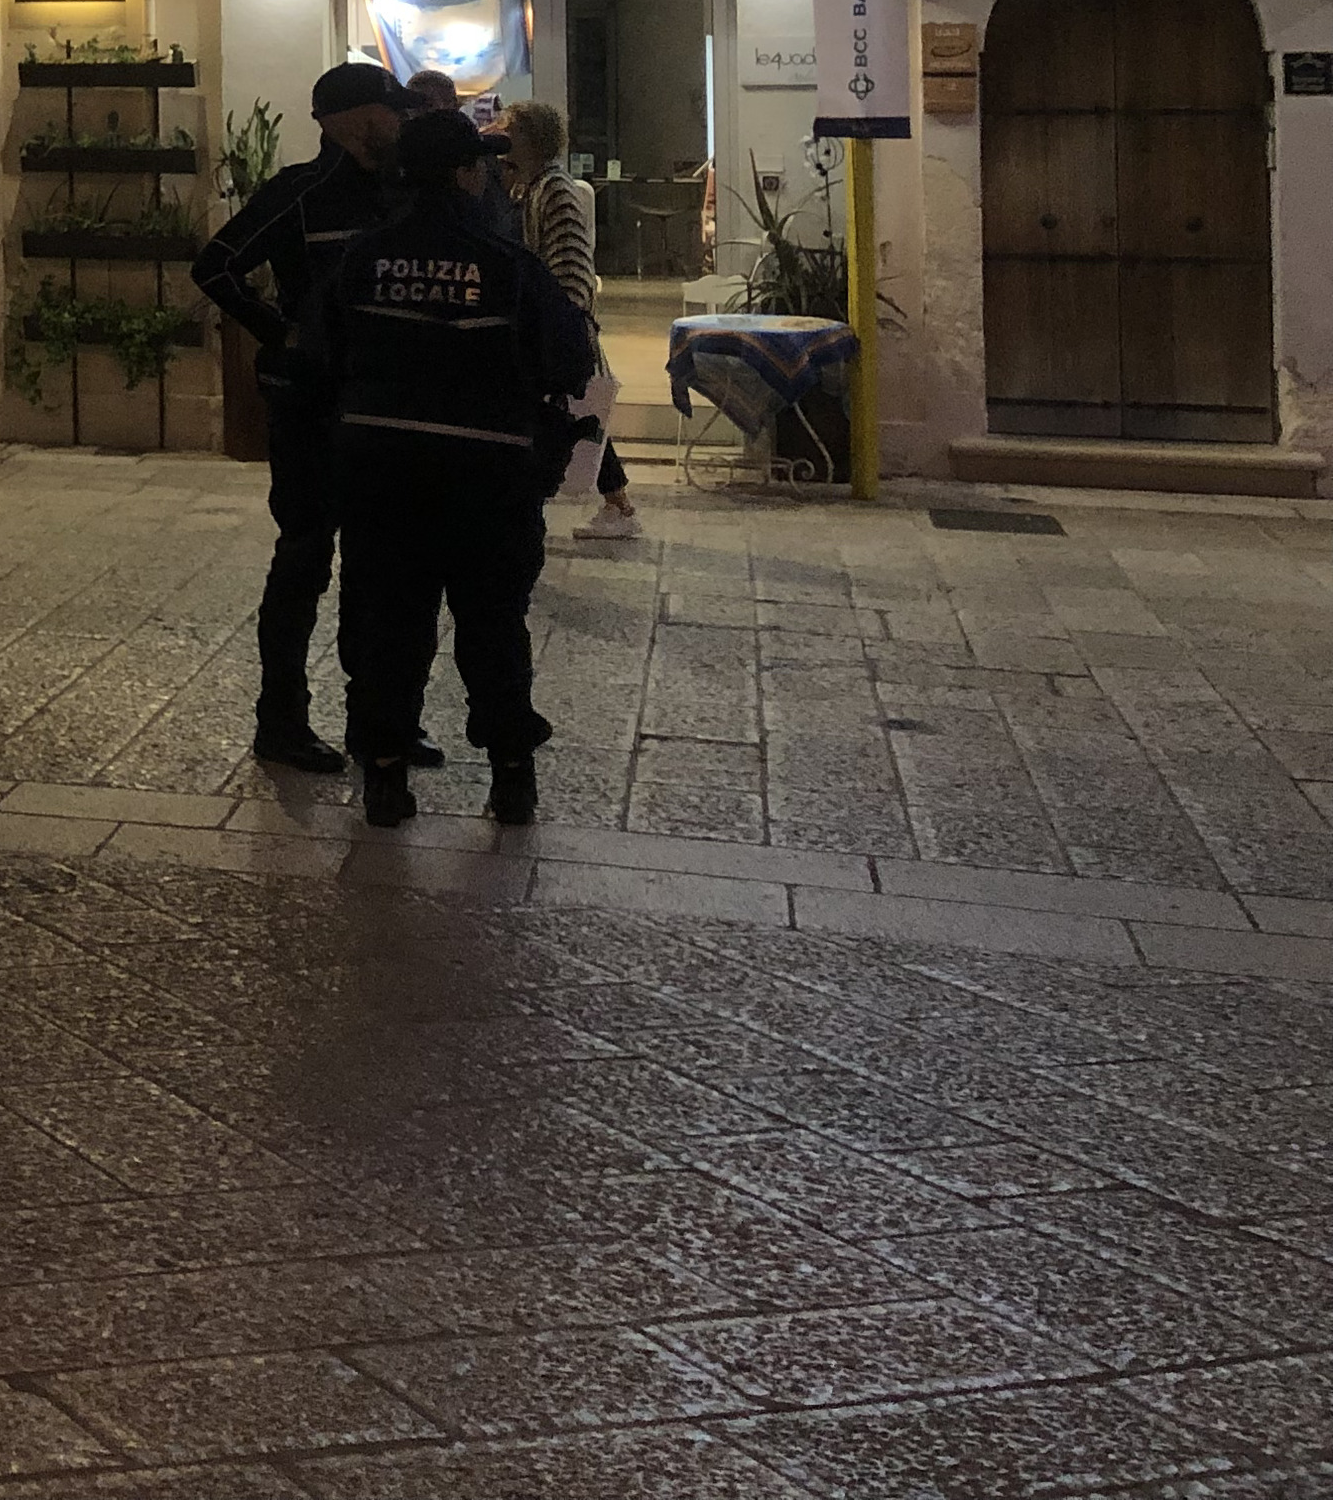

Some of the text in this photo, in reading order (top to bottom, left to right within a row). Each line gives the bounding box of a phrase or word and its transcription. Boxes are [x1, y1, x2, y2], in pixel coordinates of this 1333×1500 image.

[854, 28, 868, 68] BCC
[375, 258, 481, 283] POLIZIA
[374, 282, 481, 306] LOCALE
